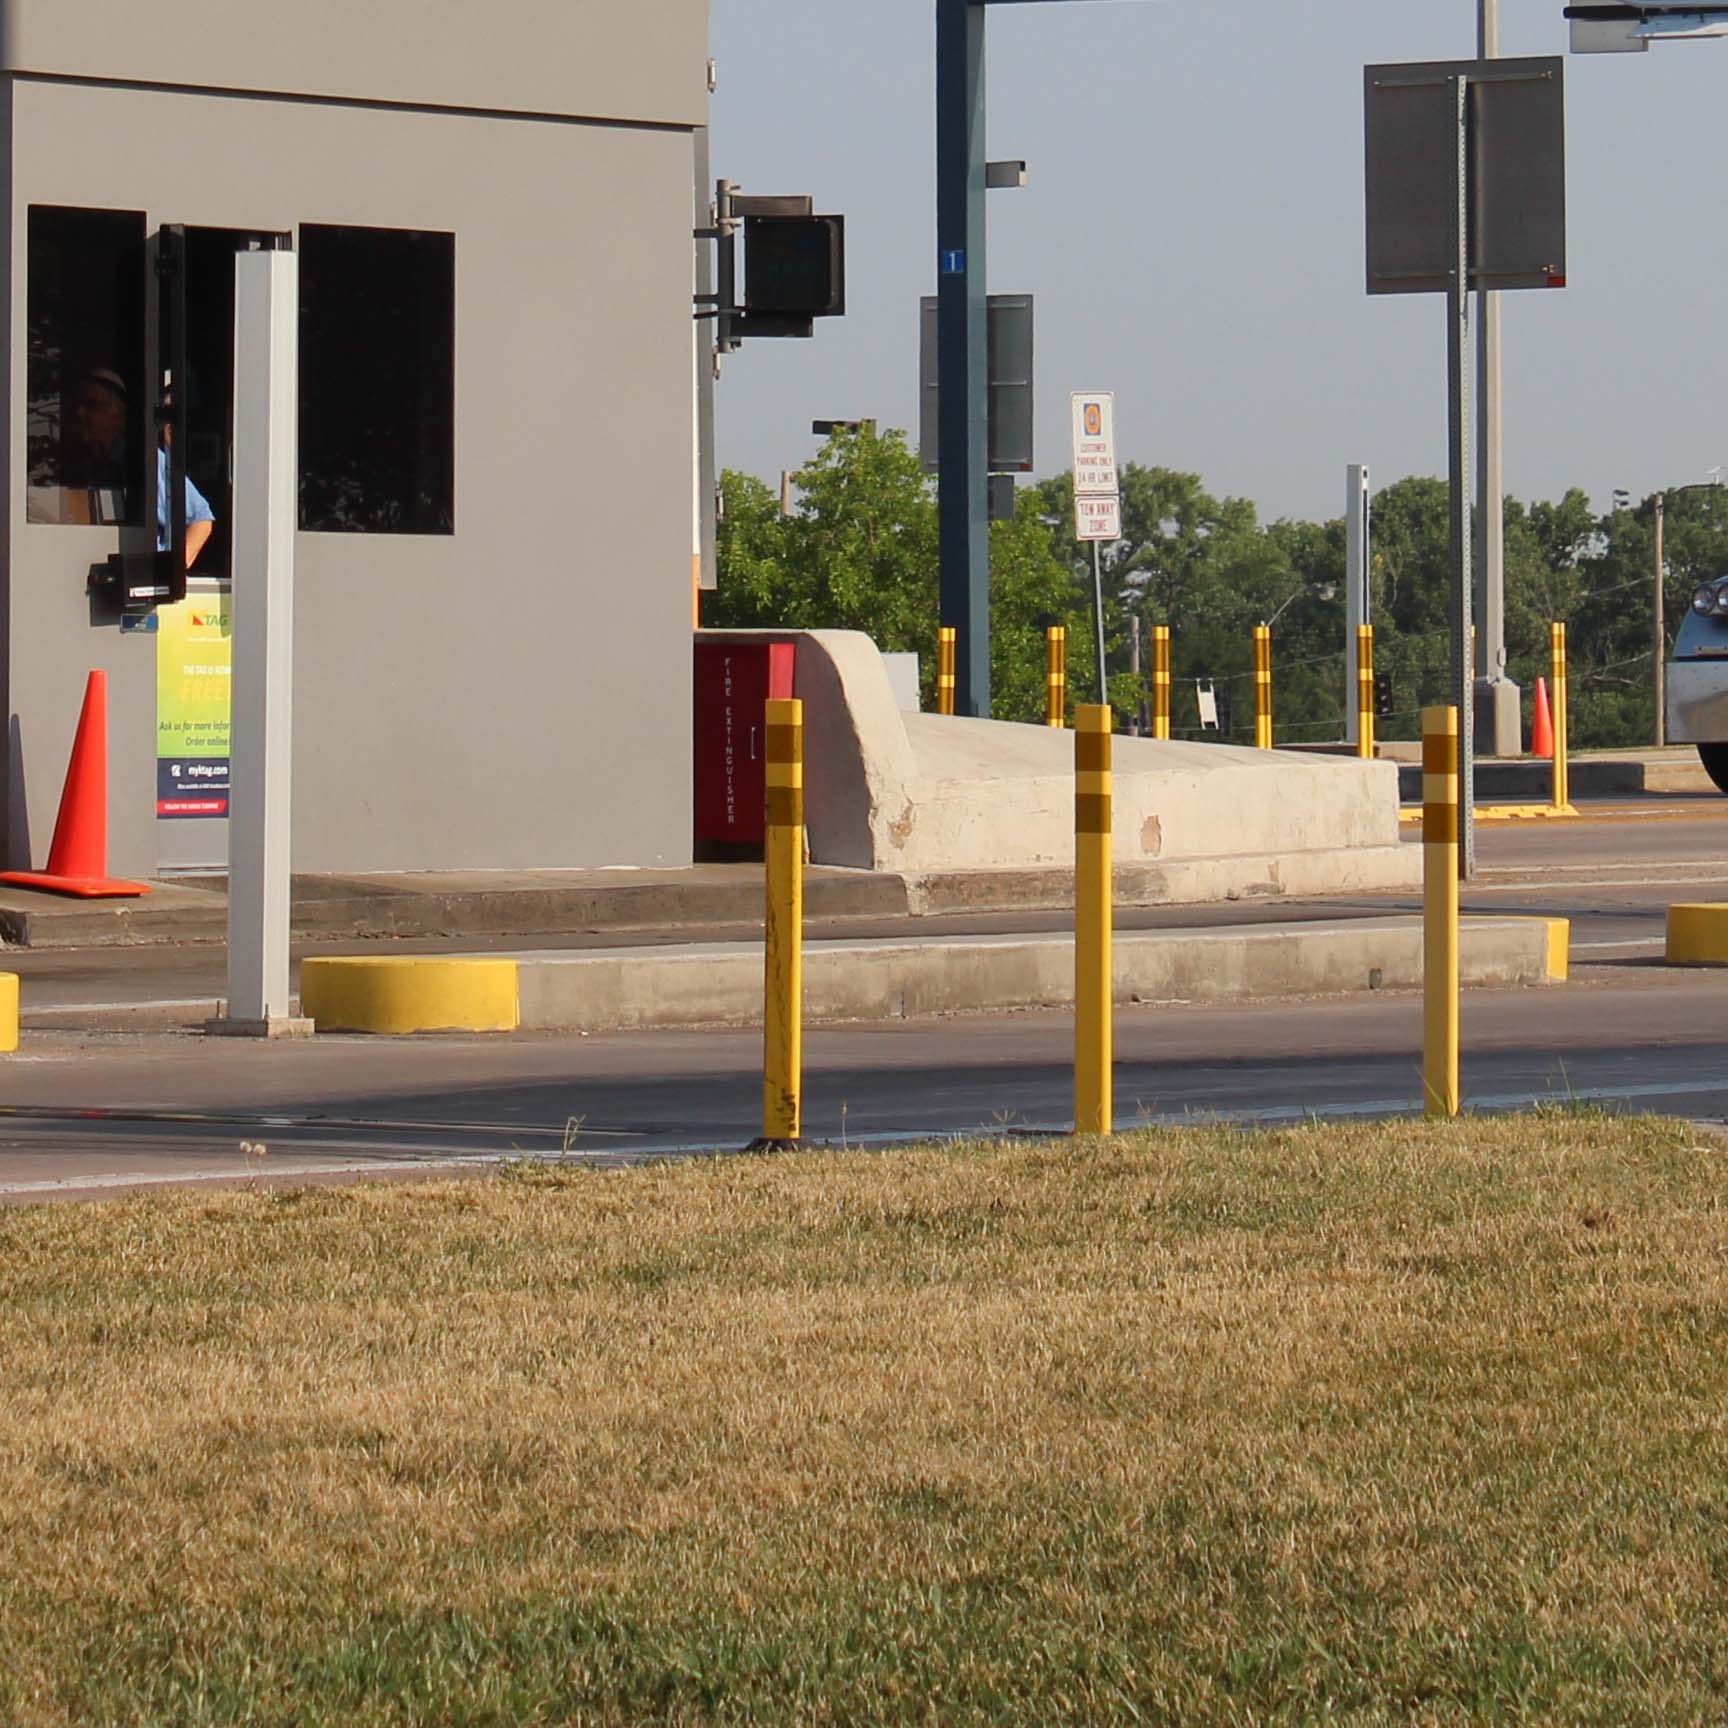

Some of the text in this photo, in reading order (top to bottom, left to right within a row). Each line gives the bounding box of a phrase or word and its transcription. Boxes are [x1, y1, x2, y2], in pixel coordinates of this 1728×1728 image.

[1077, 456, 1112, 467] PARKING ONLY
[1080, 503, 1114, 515] TOW AWAY
[1089, 520, 1106, 532] ZONE
[159, 721, 172, 730] Ask
[182, 721, 192, 733] for
[194, 722, 211, 730] more
[185, 737, 205, 746] Order
[726, 707, 734, 824] EXTINGUISHER
